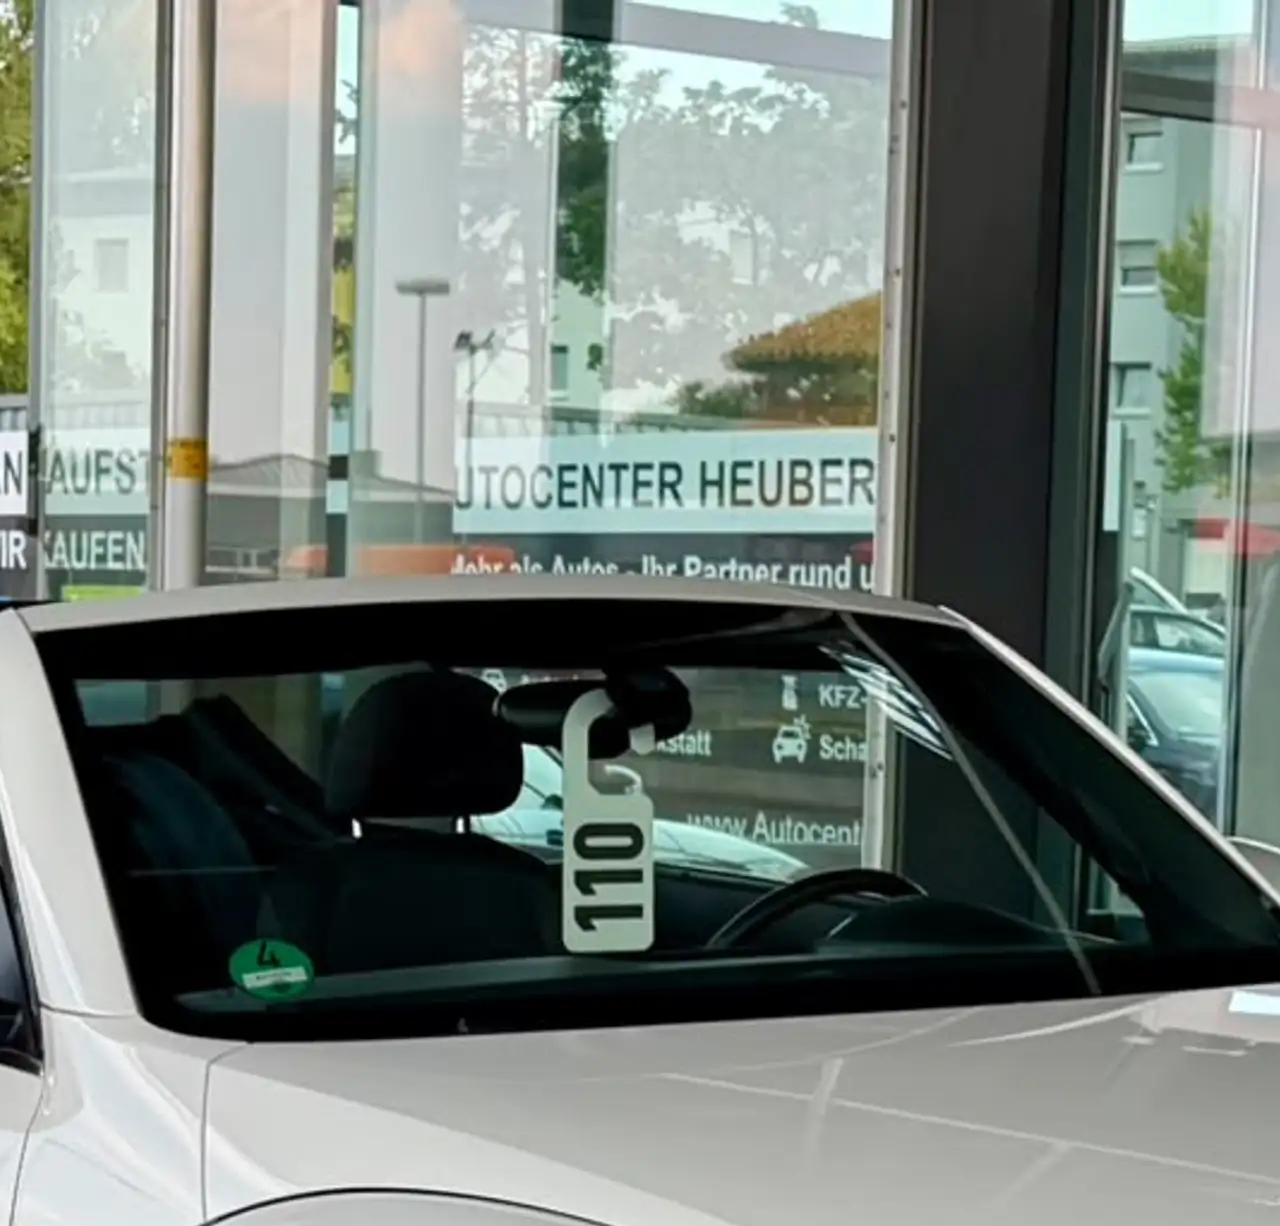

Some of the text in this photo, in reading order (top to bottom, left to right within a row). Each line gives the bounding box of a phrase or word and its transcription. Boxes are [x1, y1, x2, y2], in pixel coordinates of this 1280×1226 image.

[683, 554, 782, 583] Partner
[788, 554, 852, 590] rund
[572, 822, 644, 932] 110
